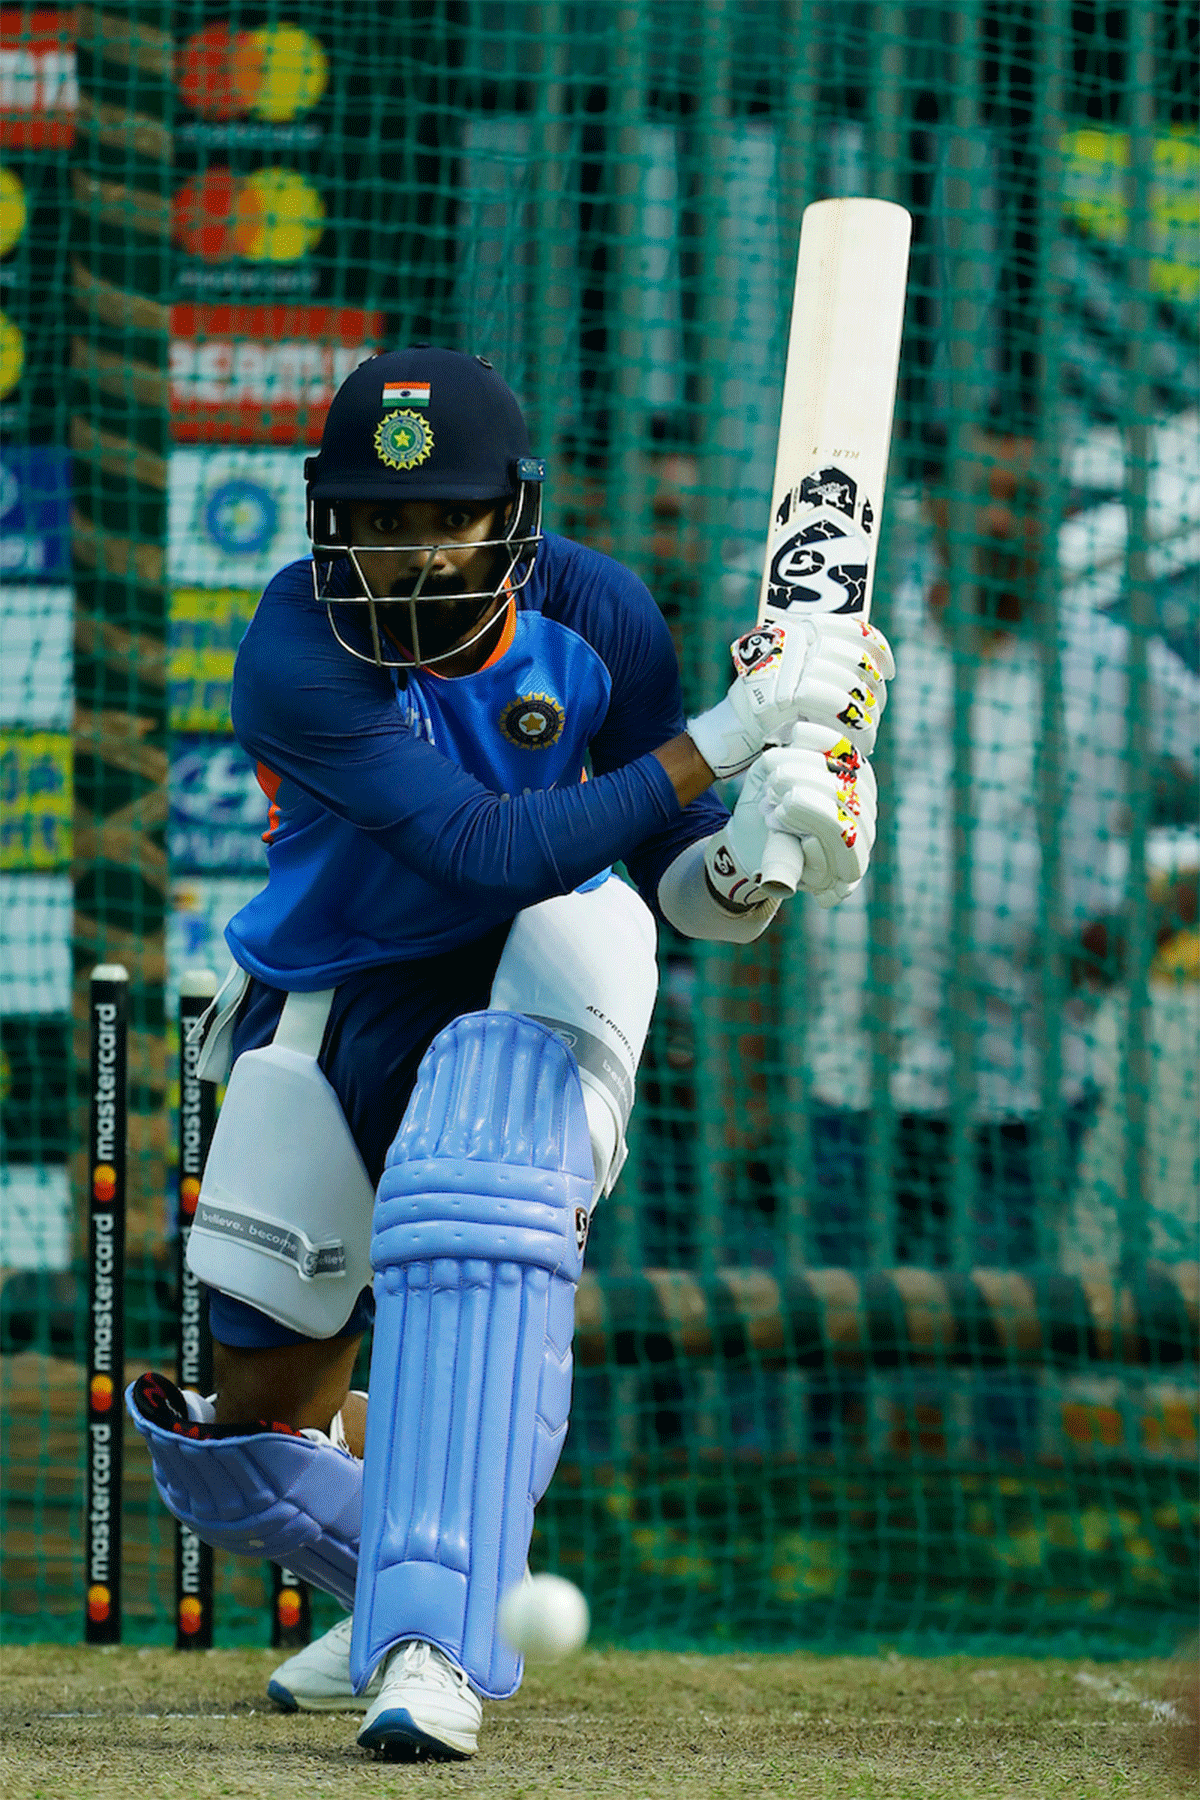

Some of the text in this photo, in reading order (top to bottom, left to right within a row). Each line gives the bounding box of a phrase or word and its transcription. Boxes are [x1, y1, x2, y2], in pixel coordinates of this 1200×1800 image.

[94, 1003, 117, 1160] mastercard
[585, 1005, 607, 1020] ACE
[92, 1214, 115, 1370] mastercard
[90, 1423, 112, 1581] mastercard
